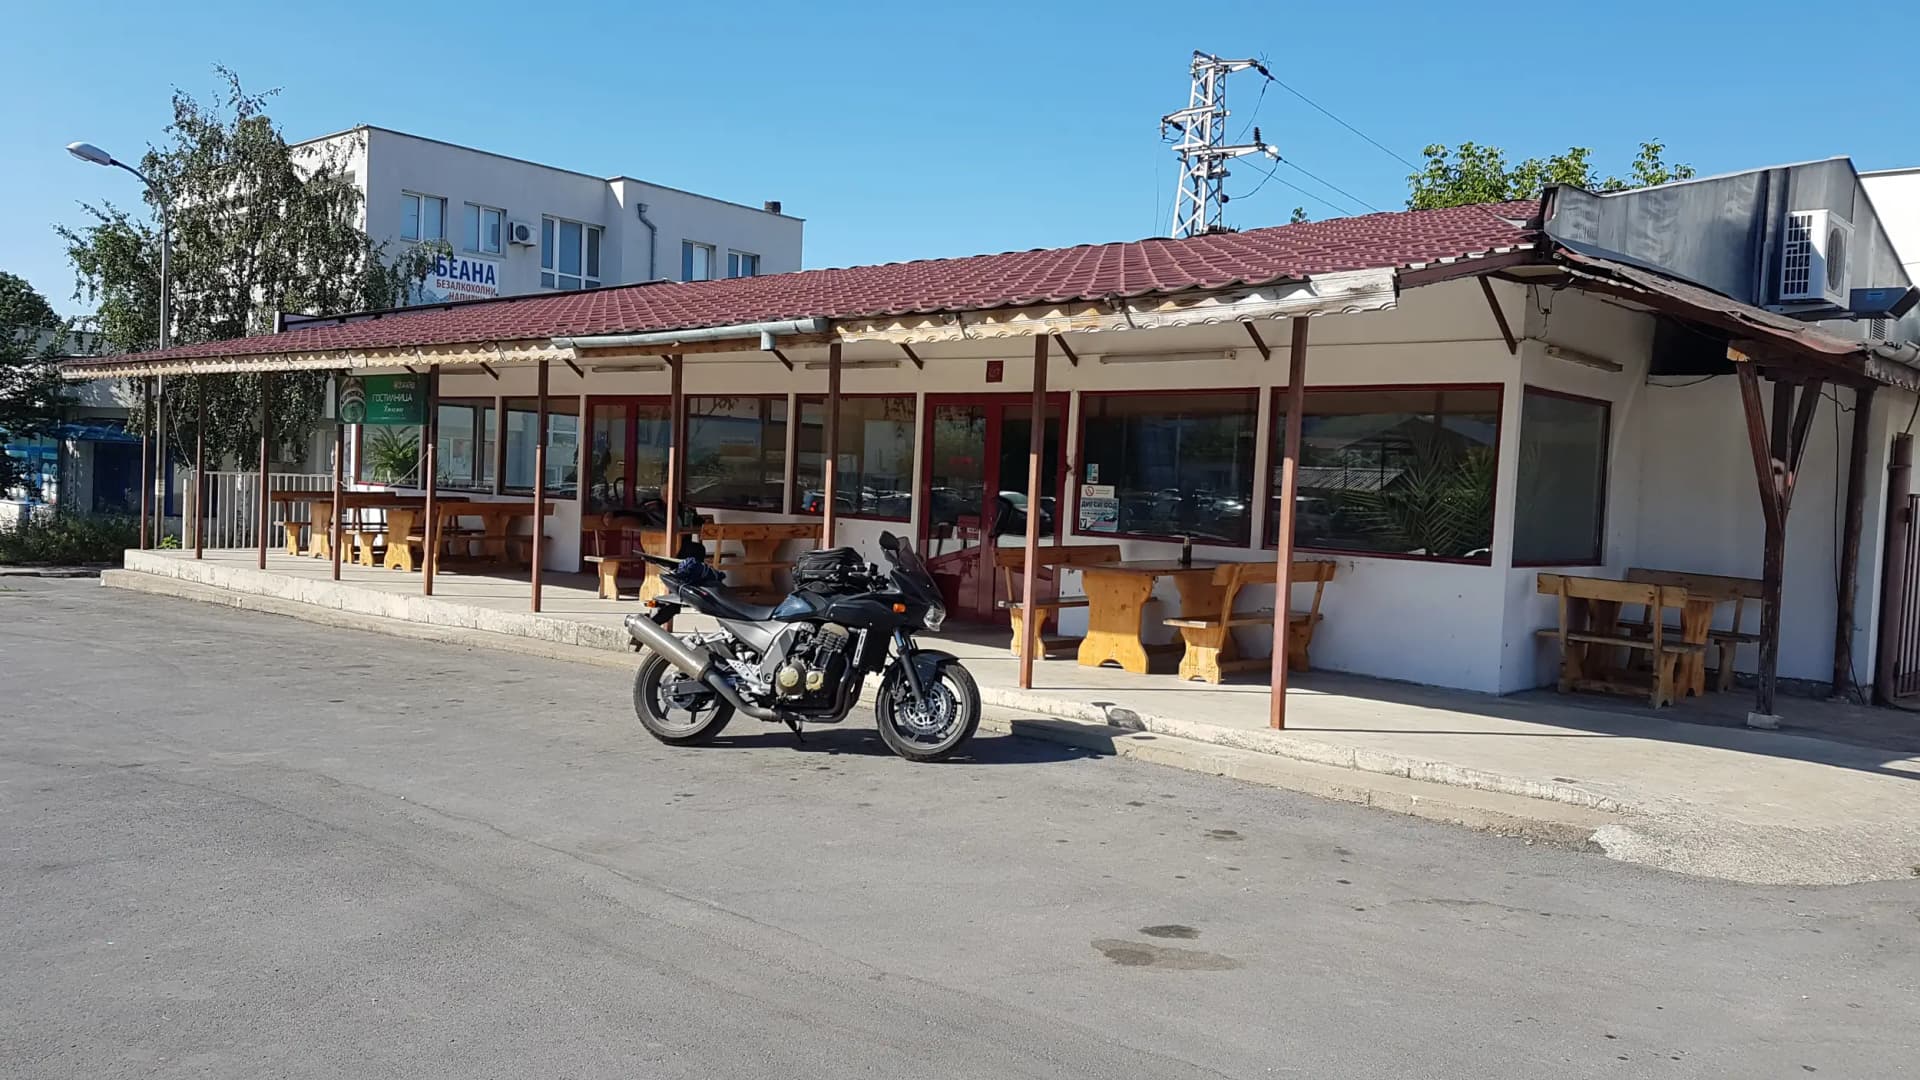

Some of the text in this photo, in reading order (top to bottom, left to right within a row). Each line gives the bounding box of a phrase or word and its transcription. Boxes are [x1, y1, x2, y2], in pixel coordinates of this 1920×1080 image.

[437, 255, 495, 285] БЕАНА
[437, 279, 496, 296] БЕЗАЛКОХОЛНИ
[372, 393, 413, 402] ГОСТИЛНИЦА
